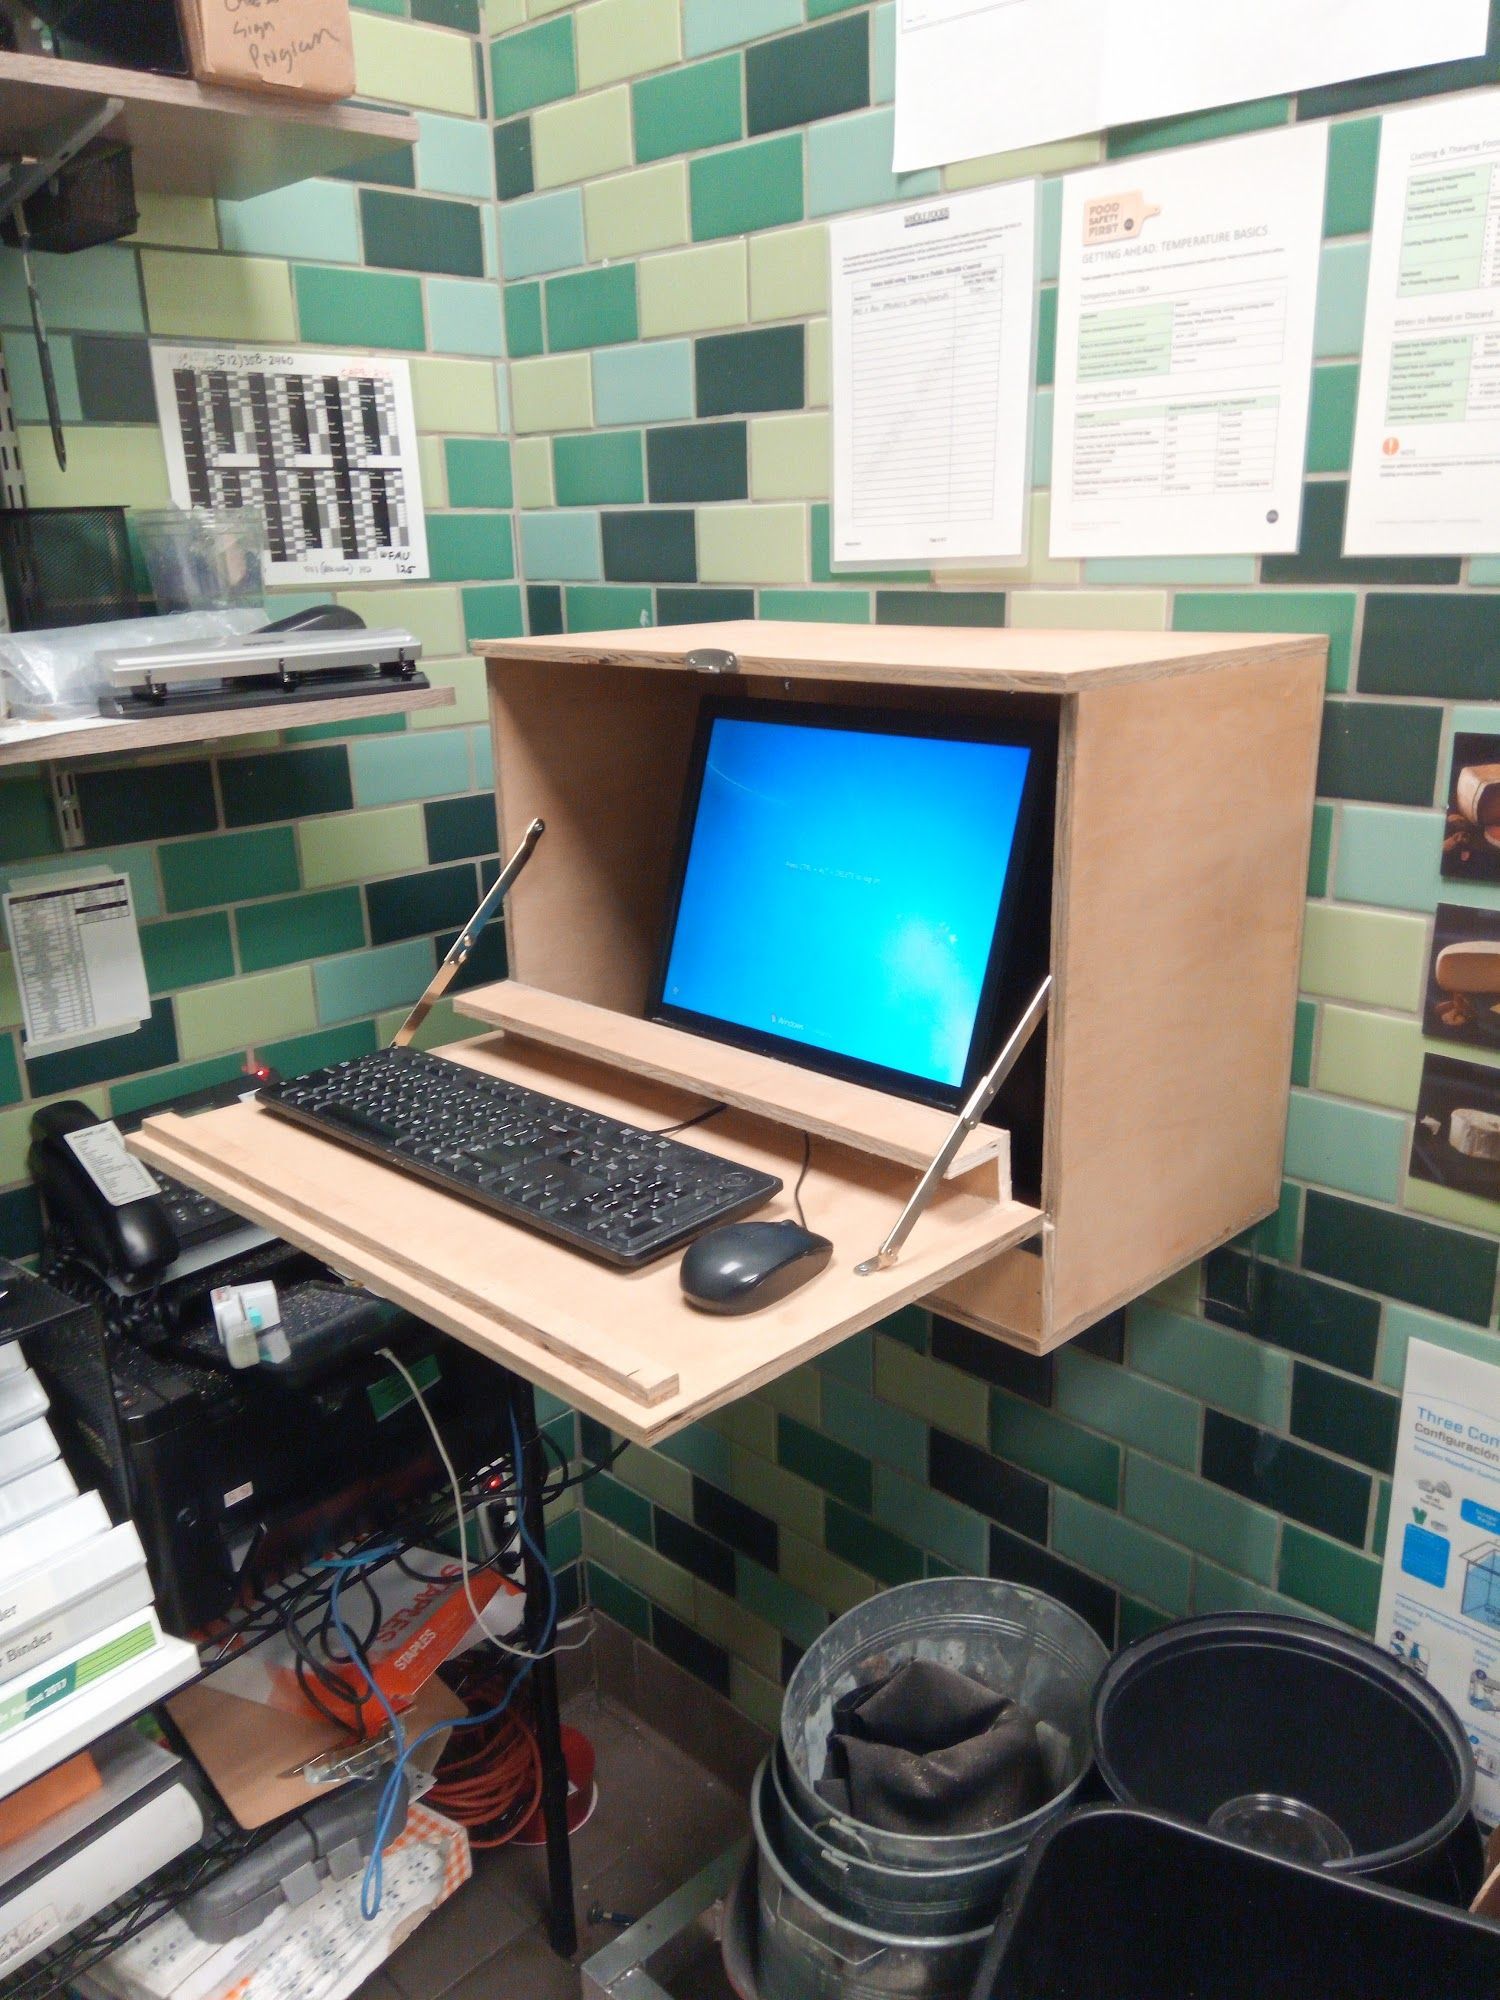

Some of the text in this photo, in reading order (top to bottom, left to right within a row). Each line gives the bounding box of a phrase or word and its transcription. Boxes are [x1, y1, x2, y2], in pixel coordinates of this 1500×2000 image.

[1089, 202, 1120, 215] FOOD
[1089, 213, 1119, 226] SAFETY
[1082, 248, 1121, 264] GETTING
[1161, 230, 1231, 252] TEMPERATURE
[1233, 224, 1268, 241] BASICS
[1088, 223, 1119, 237] FIRST
[1417, 1405, 1463, 1434] Three
[1414, 1422, 1500, 1462] Configuración
[6, 1631, 52, 1662] Binder
[394, 1628, 437, 1671] STAPLES
